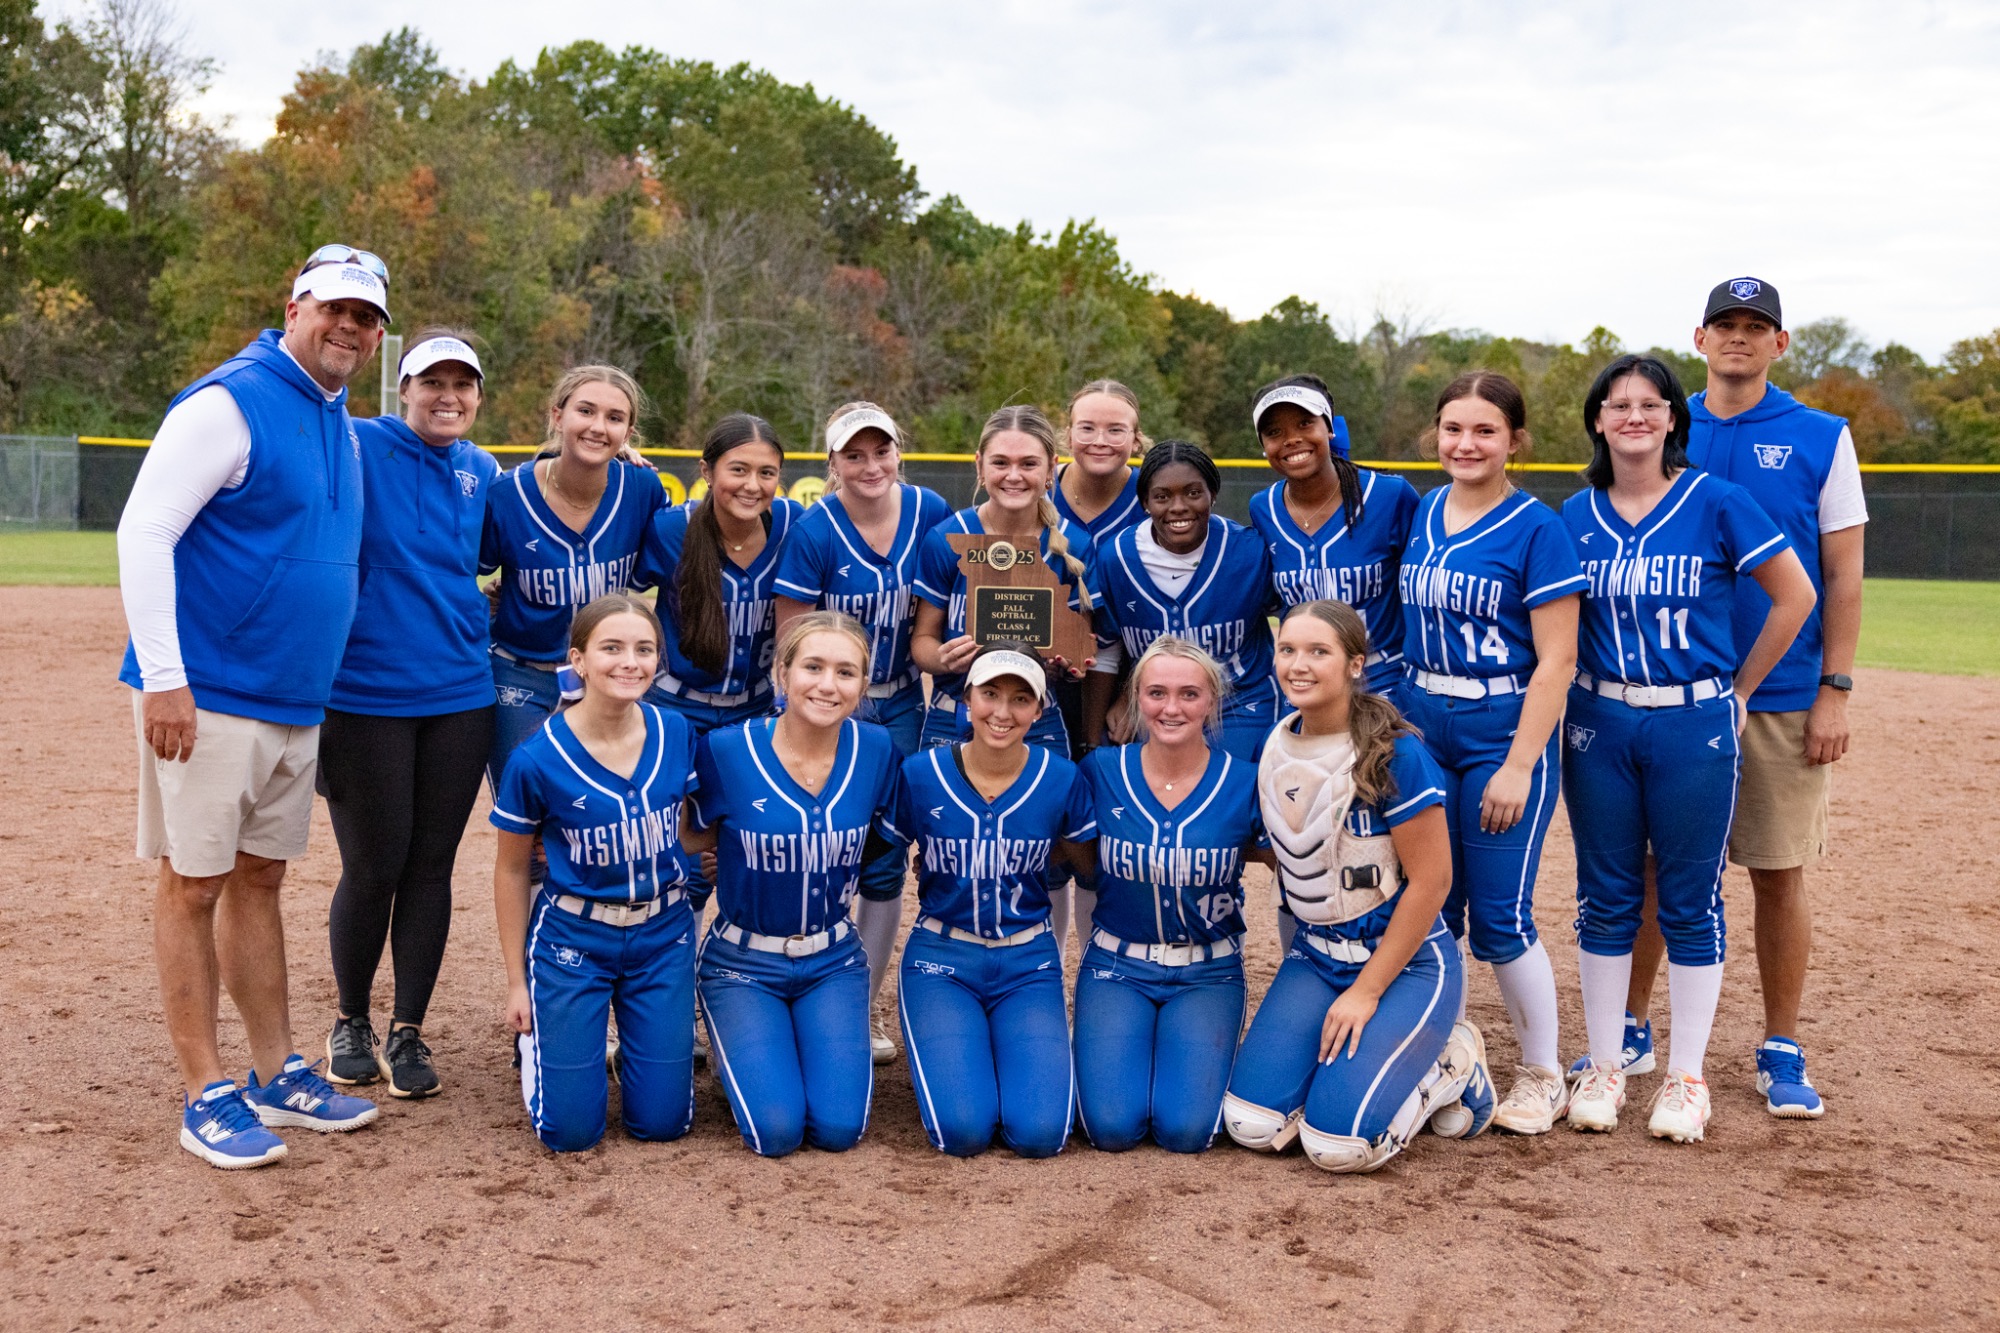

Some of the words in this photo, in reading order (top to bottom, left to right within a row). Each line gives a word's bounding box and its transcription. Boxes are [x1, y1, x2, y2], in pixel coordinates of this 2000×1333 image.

[968, 549, 986, 563] 20
[1017, 550, 1035, 564] 25
[1580, 555, 1703, 599] STMINSTER
[994, 592, 1035, 601] DISTRICT
[1003, 604, 1025, 612] FALL
[991, 611, 1036, 620] SOFTBALL
[997, 622, 1024, 631] CLASS
[1025, 623, 1031, 631] 4
[1655, 607, 1690, 649] 11
[986, 633, 1010, 641] FIRST
[1012, 634, 1041, 642] PLACE
[1460, 622, 1509, 664] 14
[739, 822, 871, 873] WESTMINST
[925, 834, 1051, 879] WESTMINSTER
[1100, 834, 1239, 887] WESTMINSTER
